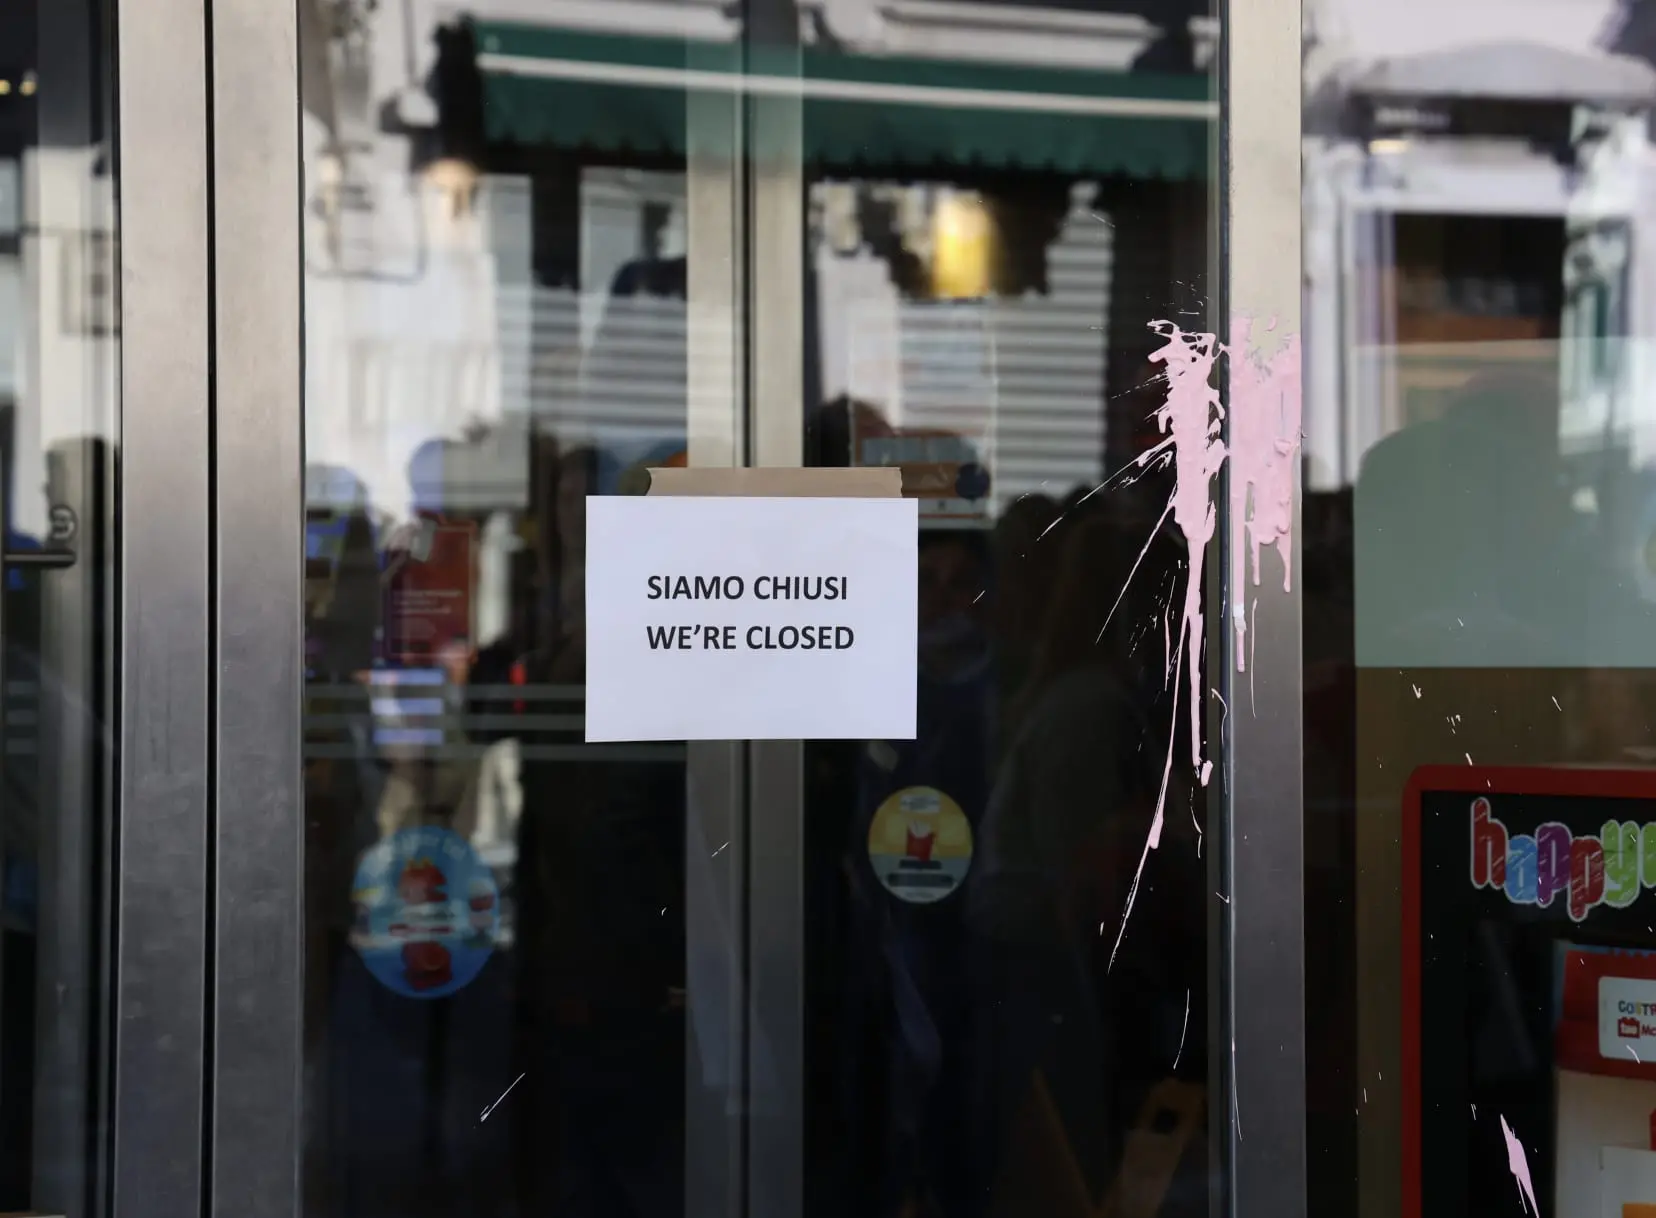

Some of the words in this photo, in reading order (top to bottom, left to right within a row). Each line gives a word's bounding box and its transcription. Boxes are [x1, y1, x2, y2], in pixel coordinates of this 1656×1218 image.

[648, 575, 745, 600] SIAMO
[754, 576, 847, 600] CHIUSI
[646, 625, 737, 649] WE’RE
[746, 626, 854, 649] CLOSED
